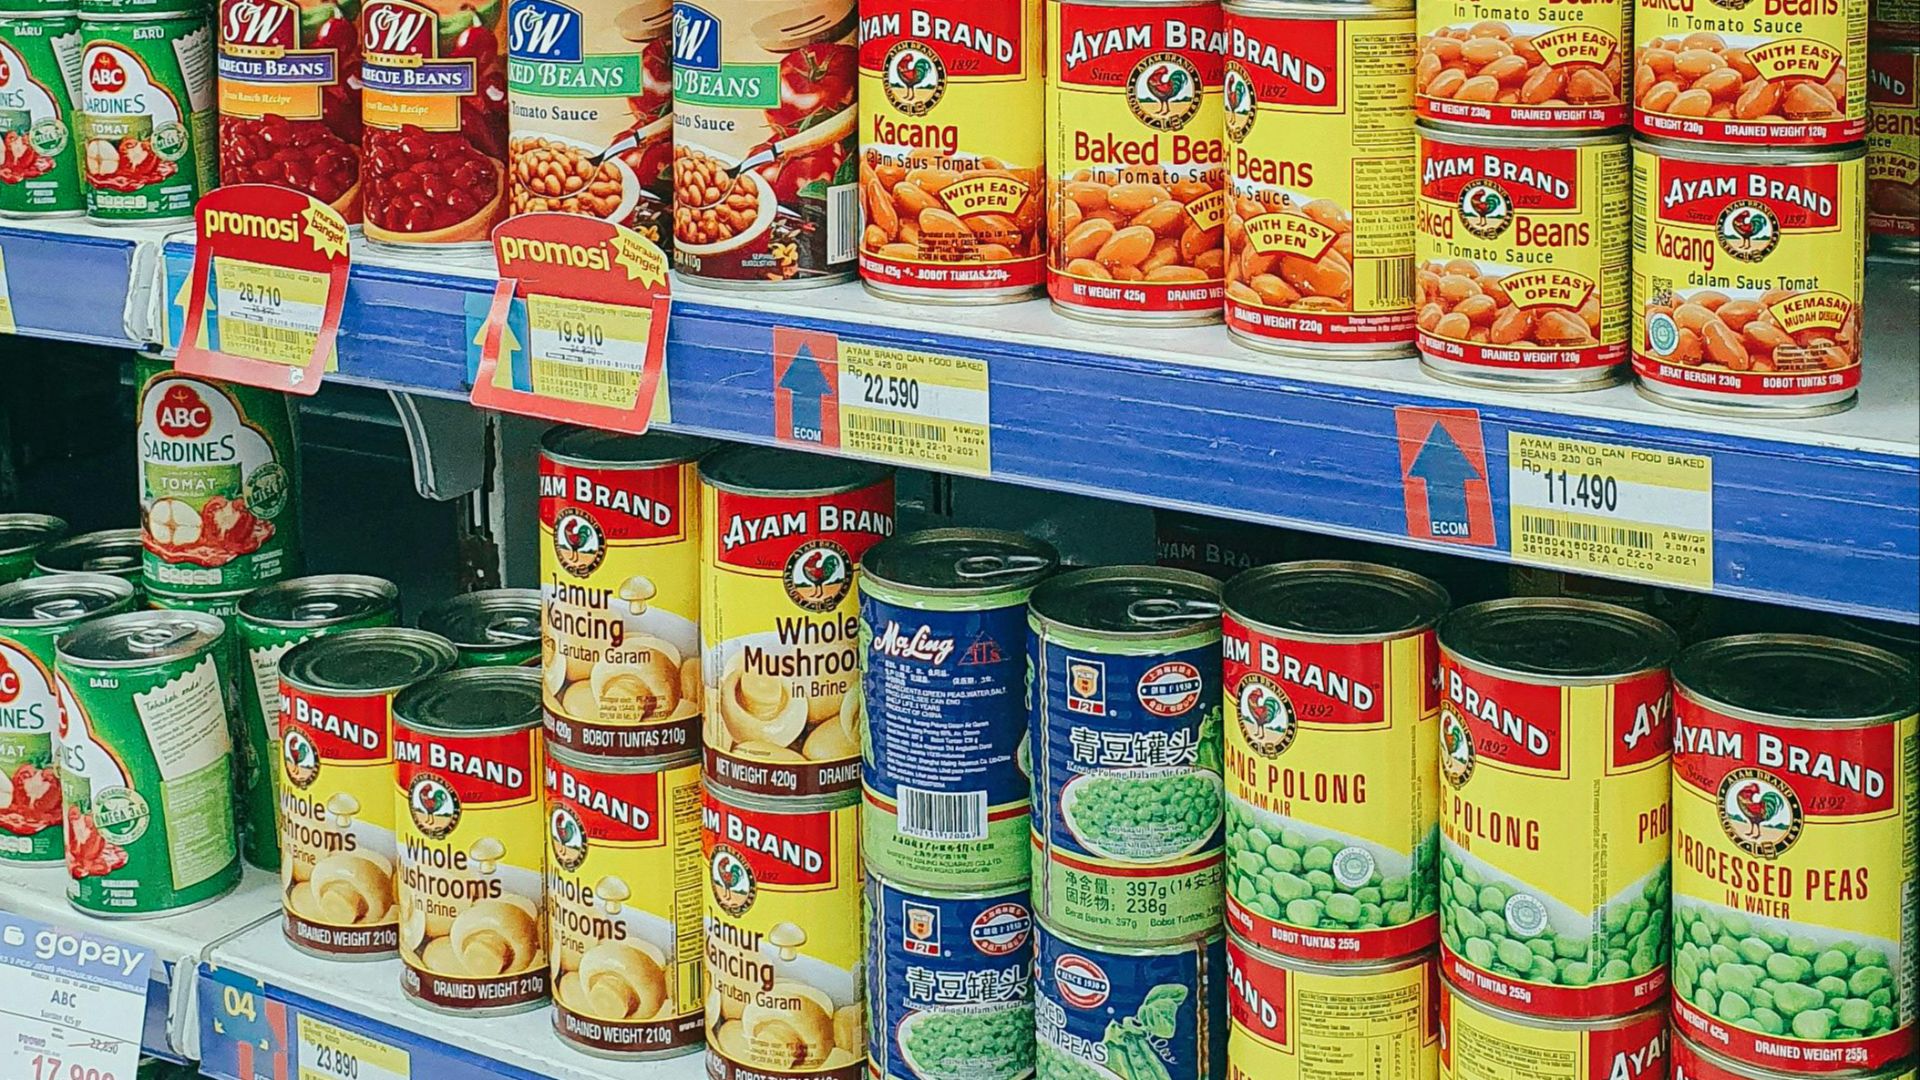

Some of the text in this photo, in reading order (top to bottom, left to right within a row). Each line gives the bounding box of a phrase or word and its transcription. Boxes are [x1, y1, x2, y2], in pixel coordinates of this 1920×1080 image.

[1474, 5, 1584, 22] Tomato Sauce
[1687, 16, 1803, 33] Tomato Sauce
[14, 27, 42, 36] BARU
[133, 28, 164, 39] BARU
[911, 9, 1014, 64] BRAND
[1537, 32, 1577, 50] WITH
[1065, 24, 1152, 71] AYAM
[1557, 44, 1598, 57] OPEN
[1752, 44, 1840, 64] WITH EASY
[266, 60, 324, 77] BEANS
[1233, 27, 1327, 94] BRAND
[1773, 58, 1820, 72] OPEN
[92, 69, 123, 85] ABC
[403, 68, 462, 86] BEANS
[538, 65, 624, 89] BEANS
[684, 71, 761, 99] BEANS
[552, 106, 598, 121] Sauce
[694, 115, 735, 132] Sauce
[874, 114, 958, 155] Kacang
[1725, 124, 1806, 138] DRAINED WEIGHT
[1075, 130, 1159, 166] Baked
[897, 153, 981, 171] Saus Tomat
[1237, 148, 1313, 189] Beans
[1115, 168, 1180, 185] Tomato
[1422, 156, 1474, 186] AYAM
[1483, 153, 1570, 200] BRAND
[944, 181, 1029, 205] WITH EASY
[964, 196, 1008, 208] OPEN
[1247, 184, 1290, 207] Sauce
[1664, 173, 1833, 218] AYAM BRAND
[204, 208, 300, 243] promosi
[311, 219, 345, 247] banget
[1248, 218, 1282, 234] WITH
[1515, 215, 1590, 247] Beans
[500, 235, 612, 272] promosi
[1263, 233, 1308, 250] OPEN
[1448, 241, 1553, 264] Tomato Sauce
[1656, 225, 1715, 272] Kacang
[621, 245, 662, 276] banget
[1506, 275, 1546, 292] WITH
[1552, 274, 1593, 293] EASY
[1688, 270, 1819, 291] dalam Saus Tomat
[238, 281, 282, 307] 28.710
[1088, 284, 1208, 304] WEIGHT 425g DRAINED
[1526, 287, 1570, 301] OPEN
[1783, 297, 1849, 315] KEMASAN
[555, 319, 604, 347] 19.910
[846, 346, 984, 372] AYAM CAN FOOD BAKED
[864, 372, 919, 410] 22.590
[1718, 374, 1795, 389] 230g BOBOT
[160, 406, 208, 428] ABC
[793, 426, 822, 442] ECOM
[143, 431, 237, 463] SARDINES
[1519, 438, 1706, 469] AYAM BRAND CAN FOOD BAKED
[1520, 448, 1558, 461] BEANS
[161, 476, 218, 491] TOMAT
[1521, 458, 1618, 513] Rp 11.490
[575, 474, 672, 528] BRAND
[722, 504, 893, 551] AYAM BRAND
[1432, 520, 1470, 537] ECOM
[1626, 548, 1698, 568] 22-12-2021
[551, 571, 613, 612] Jamur
[547, 600, 625, 648] Kancing
[776, 615, 858, 646] Whole
[558, 641, 651, 665] Larutan Garam
[89, 677, 119, 689] BARU
[791, 679, 847, 698] in Brine
[1259, 641, 1376, 712] BRAND
[1301, 703, 1335, 718] 1892
[1450, 668, 1550, 757] BRAND
[296, 696, 380, 751] BRAND
[582, 727, 686, 748] BOBOT TUNTAS 210g
[1070, 726, 1199, 767] 青豆罐头
[1478, 737, 1509, 757] 1892
[430, 746, 525, 790] BRAND
[1673, 717, 1886, 799] AYAM BRAND
[731, 762, 797, 790] WEIGHT 420g
[1268, 763, 1367, 805] POLONG
[562, 774, 651, 832] BRAND
[1272, 798, 1292, 818] AIR
[1454, 794, 1540, 852] POLONG
[404, 832, 468, 871] Whole
[727, 813, 824, 874] BRAND
[1677, 827, 1869, 902] PROCESSED PEAS
[1126, 882, 1167, 899] 397g
[426, 899, 457, 918] Brine
[1126, 900, 1167, 916] 238g
[1725, 888, 1791, 921] IN WATER
[332, 927, 397, 947] WEIGHT 210g
[709, 906, 764, 953] Jamur
[1271, 926, 1361, 952] BOBOT TUNTAS 255g
[35, 930, 146, 977] gopay
[433, 976, 544, 1000] DRAINED WEIGHT 210g
[906, 965, 1028, 1002] 青豆罐头
[1061, 970, 1083, 985] SINCE
[50, 989, 77, 1009] ABC
[223, 985, 257, 1023] 04
[714, 978, 802, 1011] Larutan Garam
[1508, 985, 1532, 1004] 255g
[603, 1024, 672, 1044] WEIGHT 210g
[316, 1042, 359, 1080] 23.890
[1755, 1039, 1843, 1062] DRAINED WEIGHT
